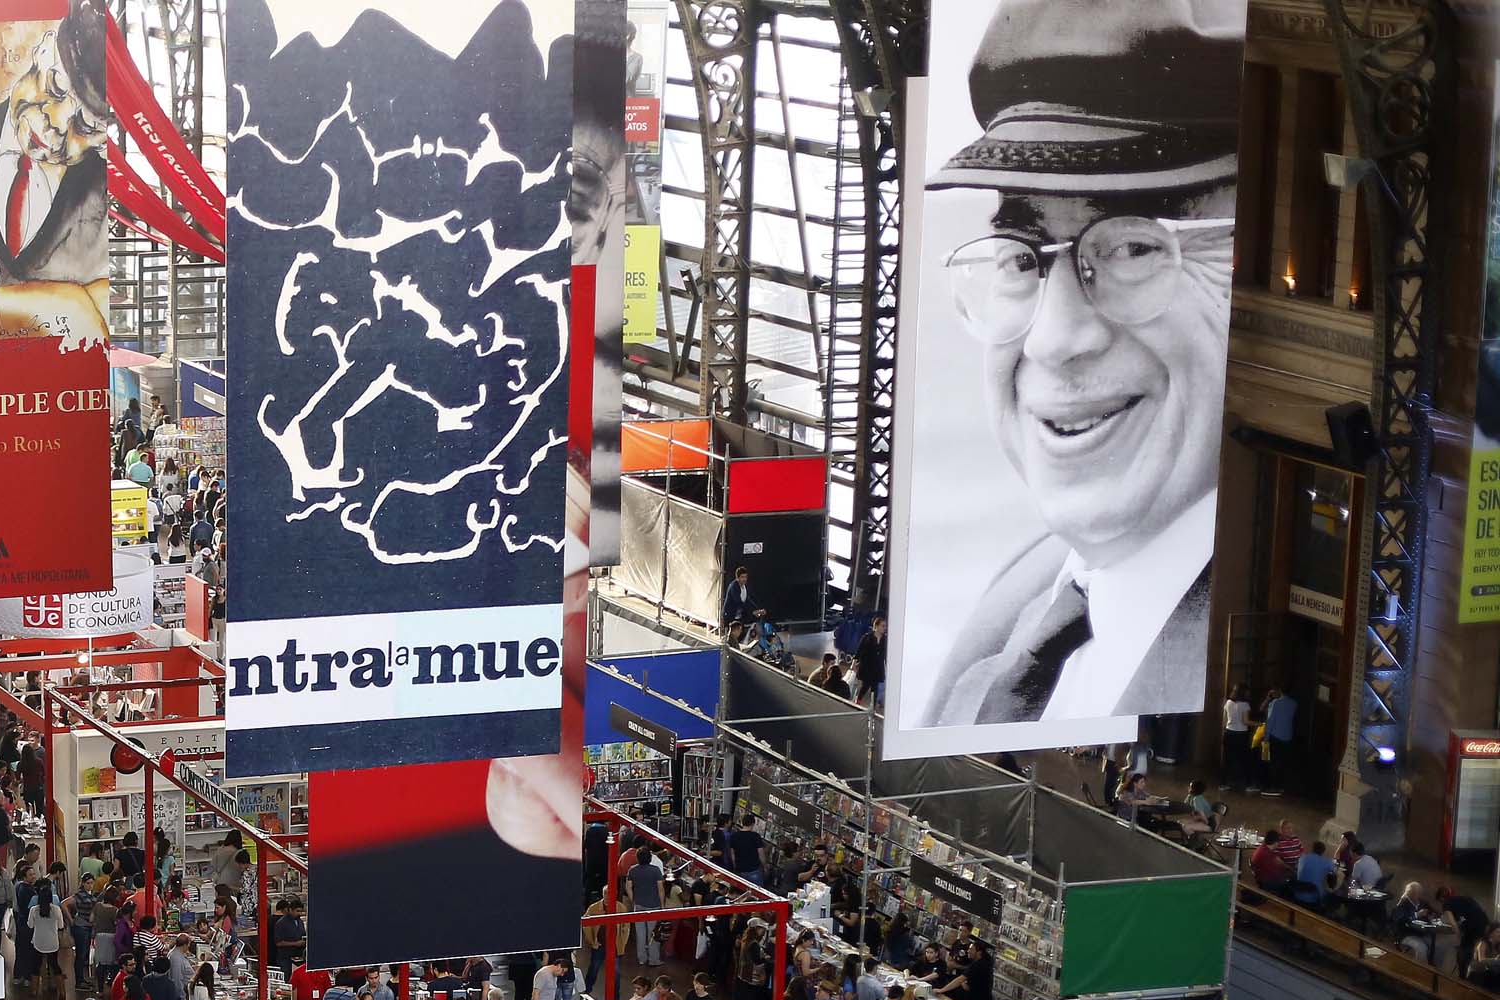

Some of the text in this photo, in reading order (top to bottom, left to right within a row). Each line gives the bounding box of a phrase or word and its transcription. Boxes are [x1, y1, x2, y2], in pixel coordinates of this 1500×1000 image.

[1476, 518, 1494, 540] DE
[69, 598, 142, 614] DE CULTURA
[69, 614, 142, 628] ECONÓMICA
[412, 636, 562, 685] mue
[179, 762, 238, 819] CONTRAPUNTO
[935, 876, 972, 902] CRAZY ALL COMICS
